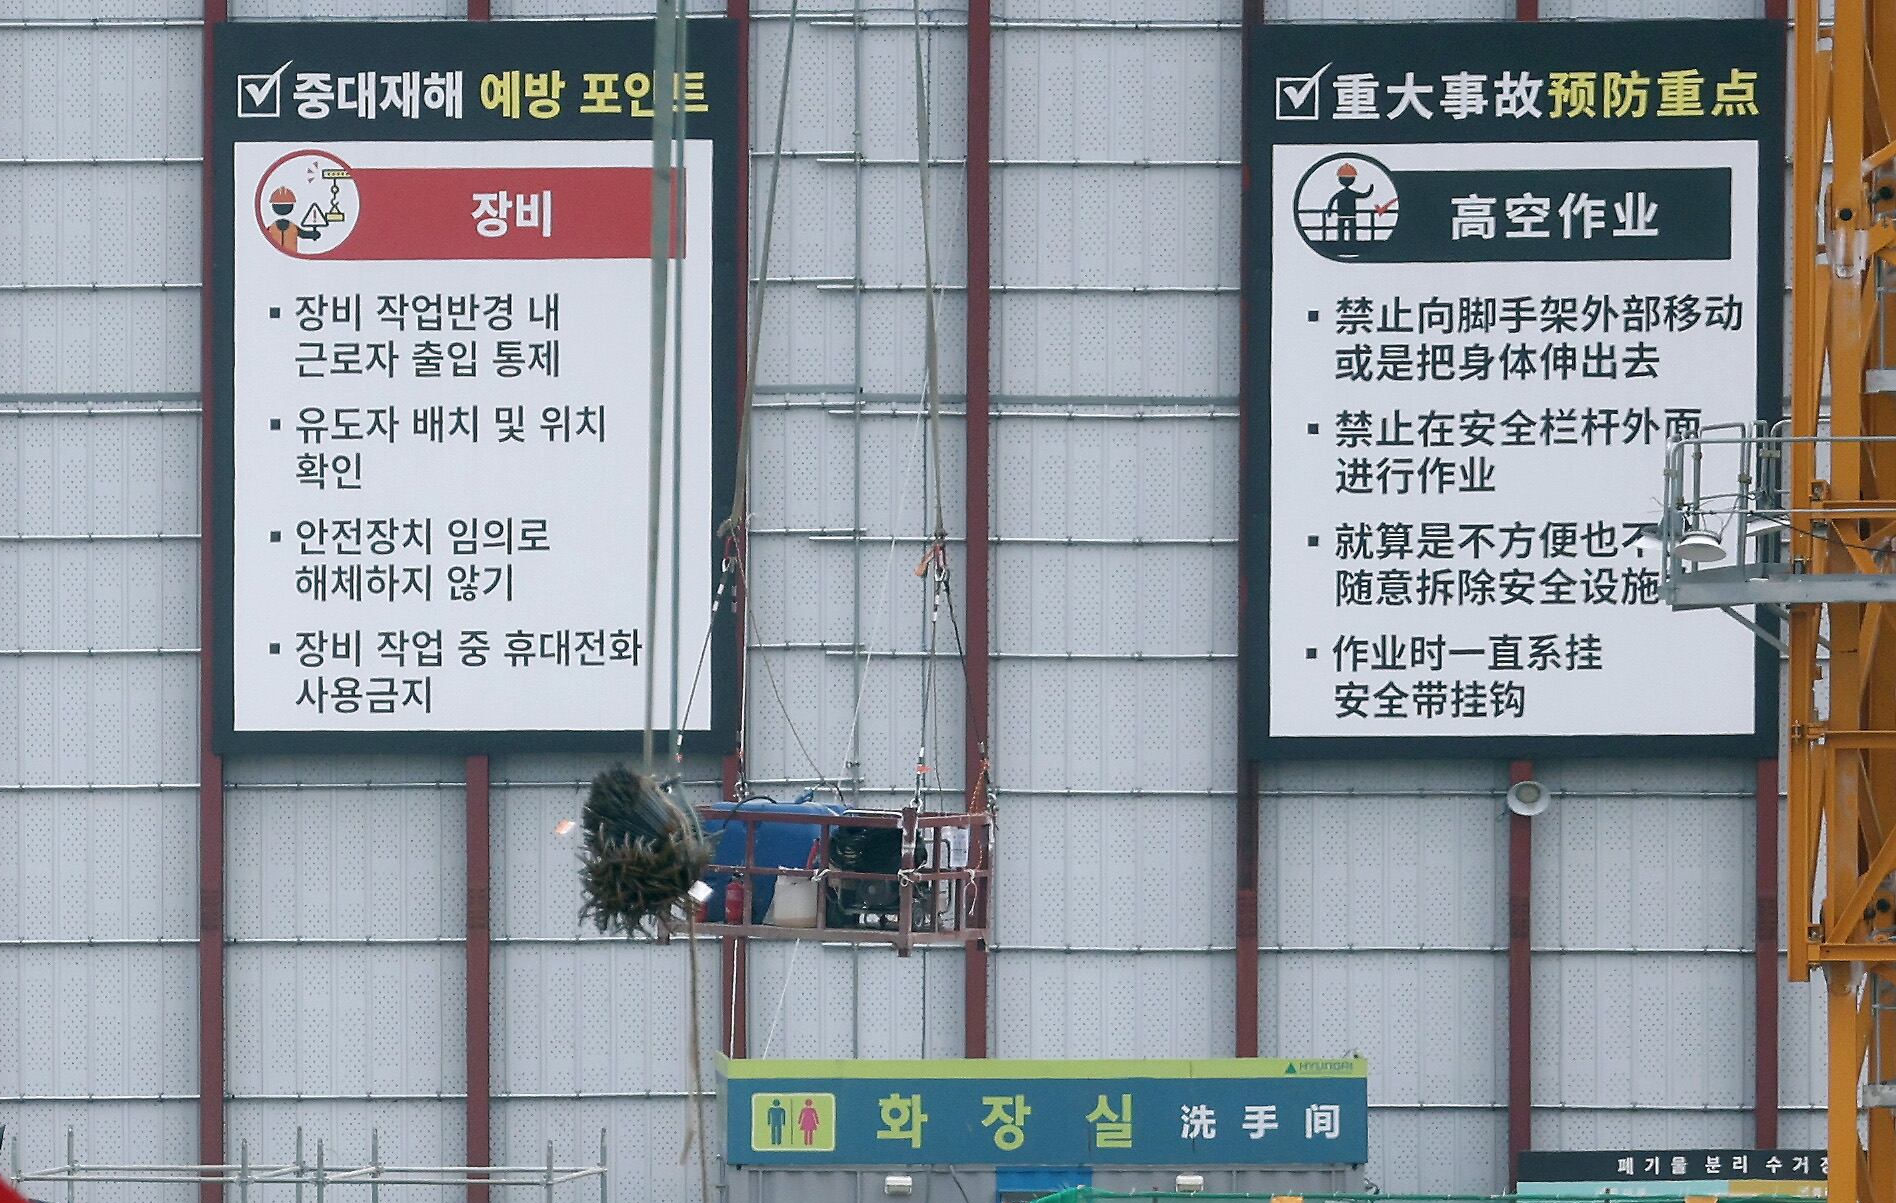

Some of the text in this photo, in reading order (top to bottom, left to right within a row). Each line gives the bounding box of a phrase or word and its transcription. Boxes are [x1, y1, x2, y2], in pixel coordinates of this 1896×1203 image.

[293, 70, 708, 119] 중대재해 예방 포인트
[1333, 69, 1758, 119] 重大事故预防重点
[472, 191, 551, 237] 장비
[1452, 192, 1658, 240] 高空作业
[296, 293, 558, 331] 장비 작업반경 내
[1336, 294, 1743, 335] 禁止向脚手架外部移动
[295, 340, 558, 378] 근로자 출입 통제
[1336, 341, 1659, 381] 或是把身体伸出去
[296, 405, 604, 444] 유도자 배치 및 위치
[296, 453, 361, 489] 확인
[1336, 456, 1495, 494] 进行作业
[297, 518, 550, 555] 안전장치 임의로
[1335, 521, 1671, 561] 就算是不方便也不
[296, 564, 431, 602] 해체하지
[1335, 567, 1659, 606] 随意拆除安全设施
[296, 629, 642, 667] 장비 작업 중 휴대전화
[1333, 633, 1602, 672] 作业时一直系挂
[296, 677, 430, 713] 사용금지
[1335, 680, 1524, 719] 安全带挂钩
[876, 1092, 1134, 1150] 화장실
[1180, 1103, 1341, 1140] 洗手间
[1617, 1155, 1687, 1176] 폐기물
[1705, 1155, 1748, 1174] 분리
